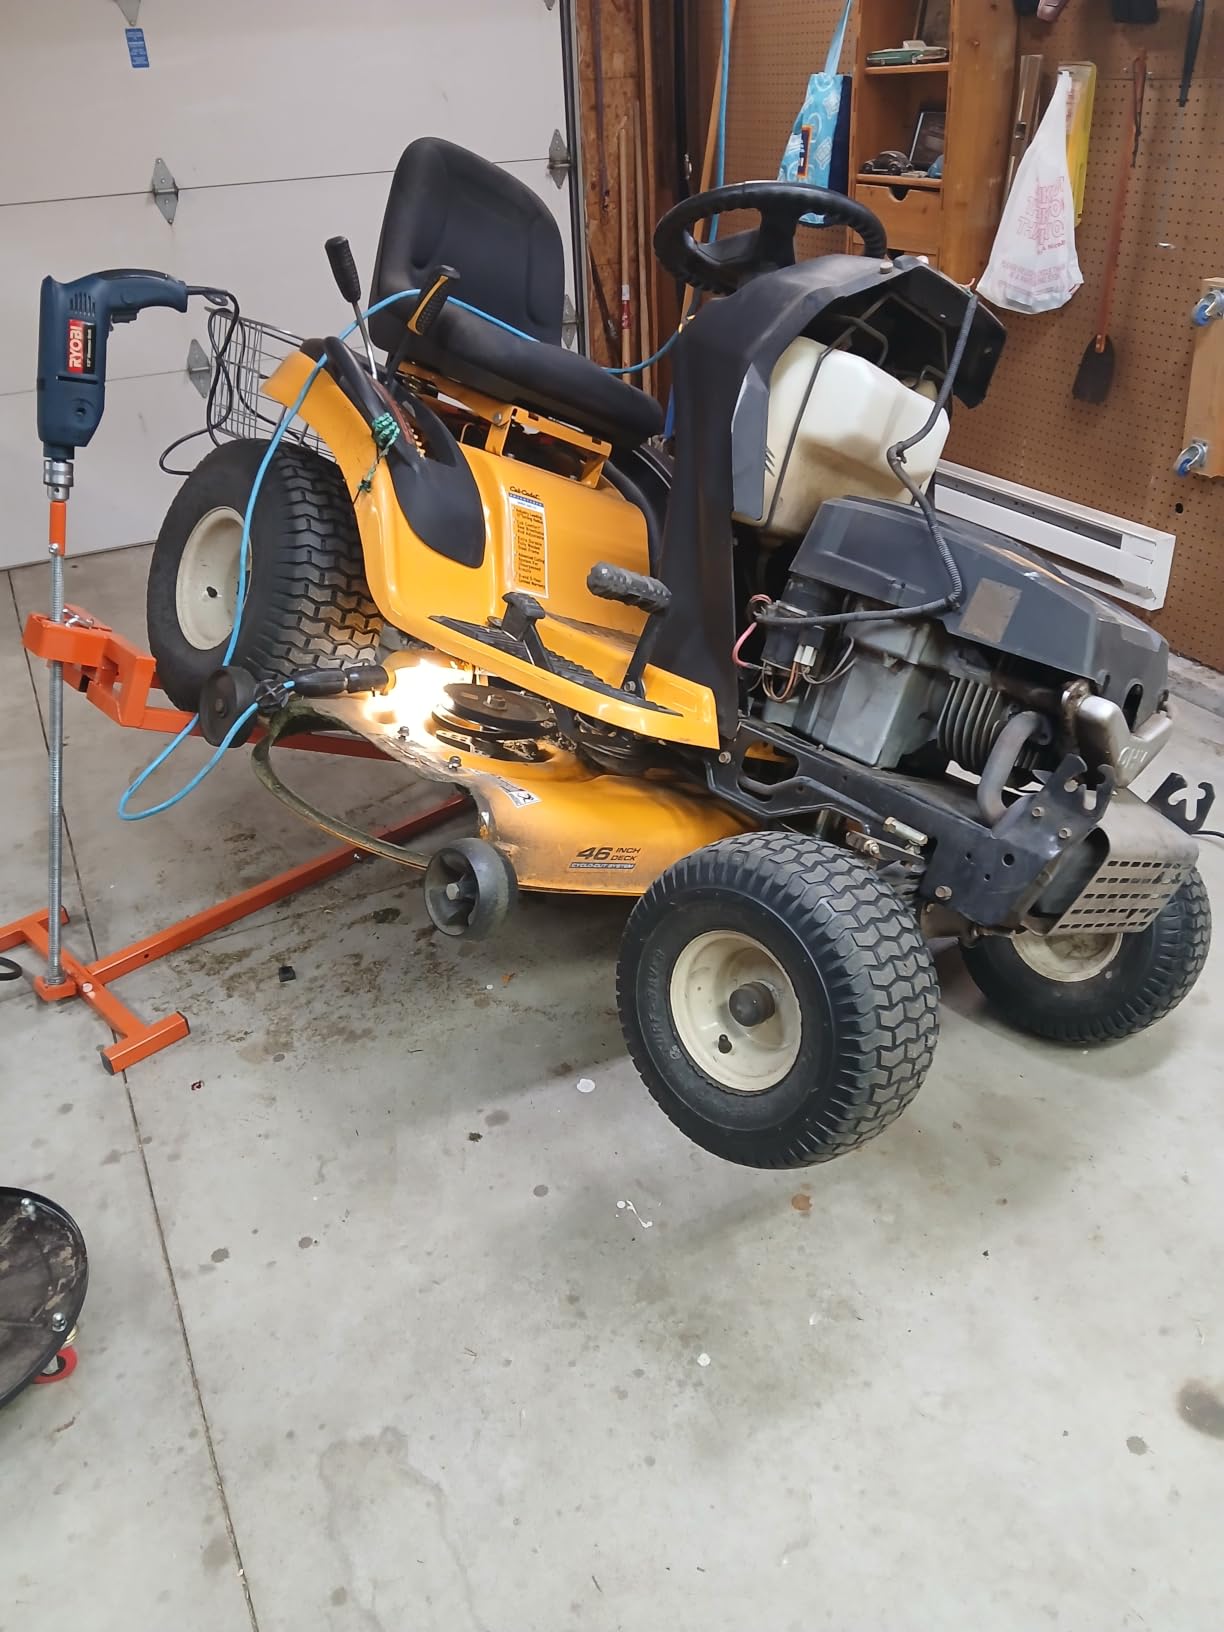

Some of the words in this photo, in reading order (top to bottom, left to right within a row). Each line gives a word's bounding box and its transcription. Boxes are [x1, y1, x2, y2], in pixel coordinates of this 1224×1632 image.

[69, 326, 83, 367] RYOBI
[510, 486, 521, 494] Cub
[521, 490, 542, 501] Cadet
[576, 847, 613, 860] 46
